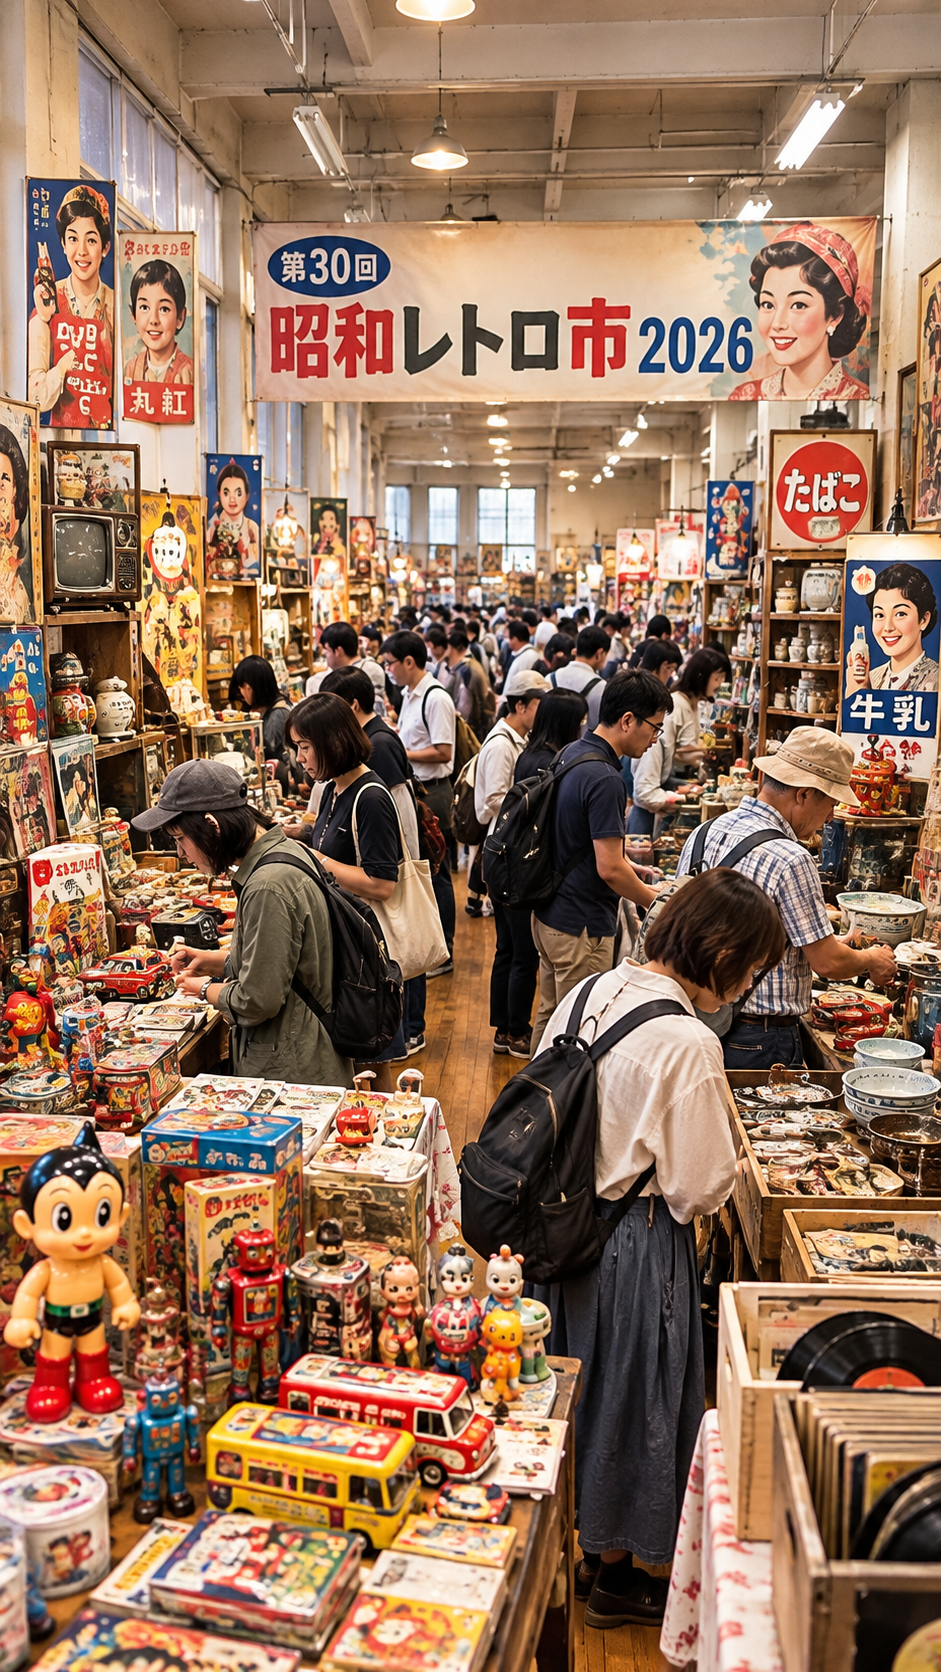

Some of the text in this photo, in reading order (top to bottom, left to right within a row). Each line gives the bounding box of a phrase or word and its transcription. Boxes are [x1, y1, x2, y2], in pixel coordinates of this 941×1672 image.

[281, 247, 377, 285] 第30回
[270, 297, 754, 379] 昭和レトロ市 2026
[784, 468, 861, 513] たばこ
[850, 693, 931, 732] 牛乳
